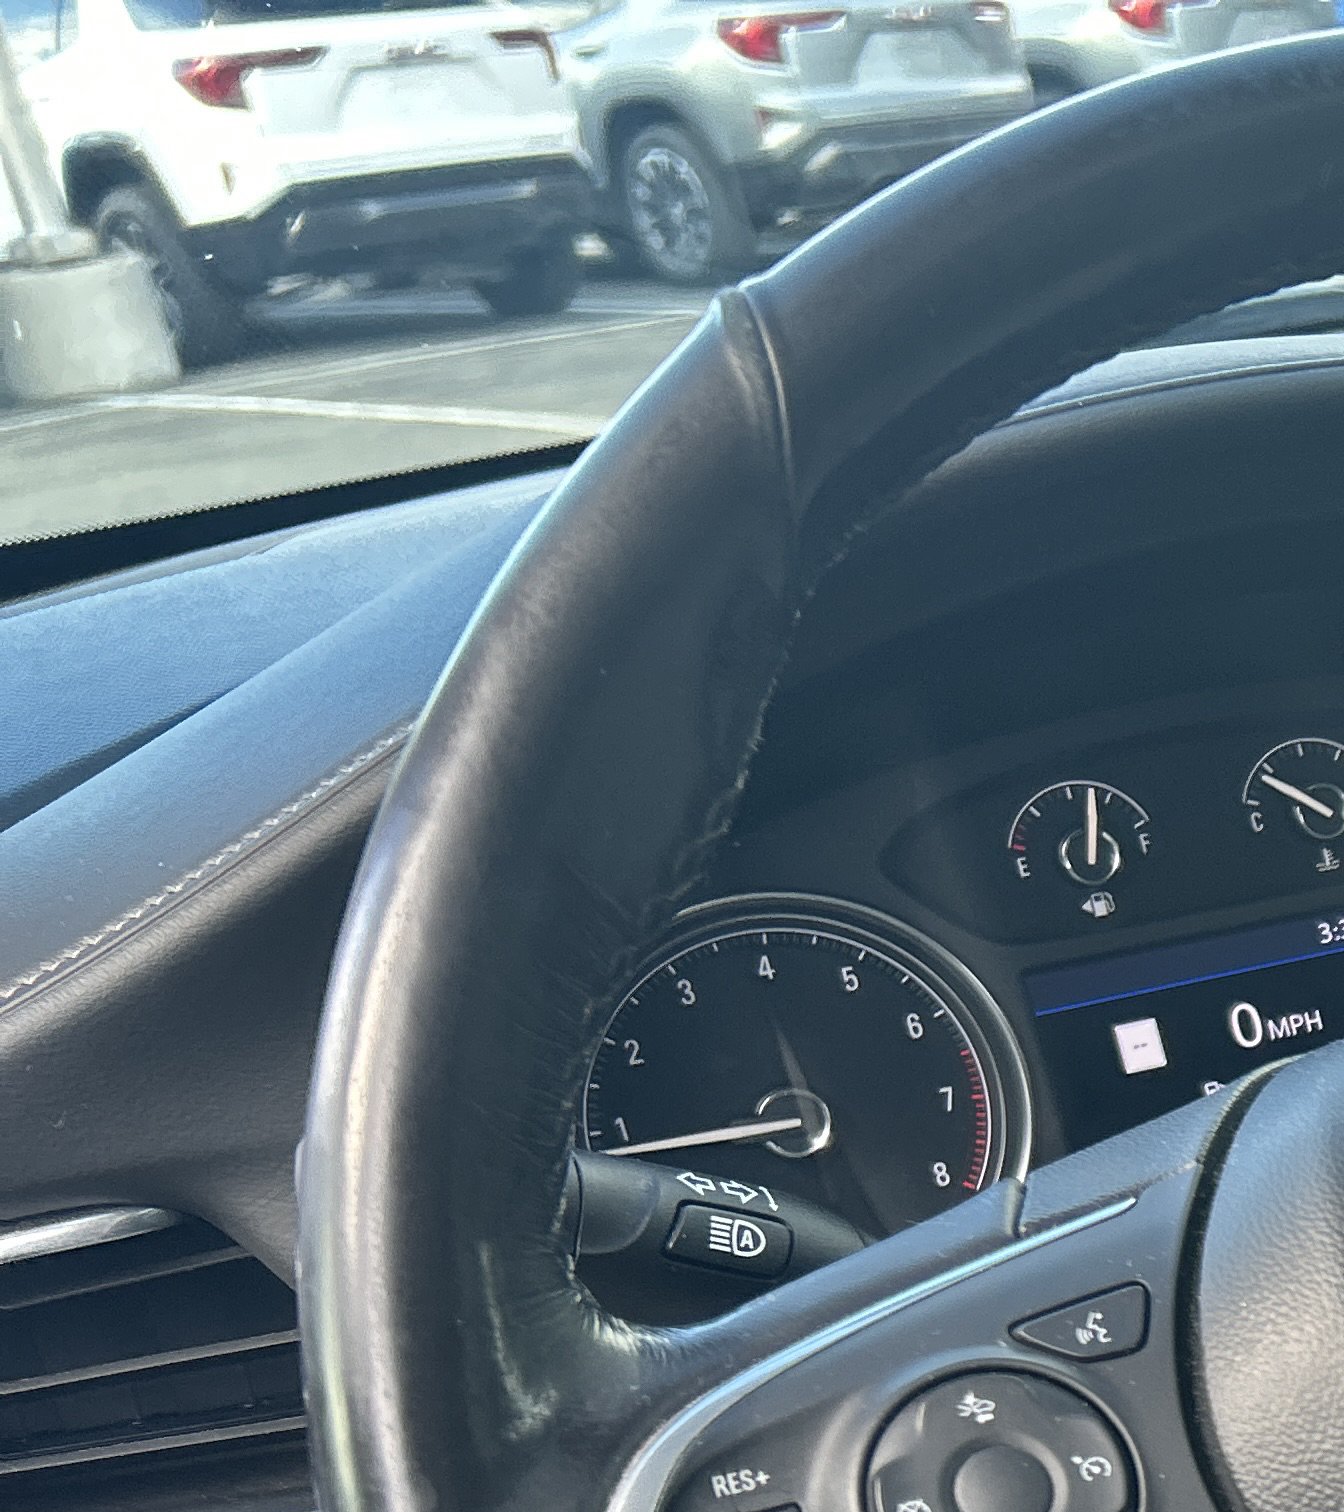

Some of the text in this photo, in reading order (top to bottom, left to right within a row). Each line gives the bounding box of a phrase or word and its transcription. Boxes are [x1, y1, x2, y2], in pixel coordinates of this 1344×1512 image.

[1250, 812, 1264, 833] C
[1140, 833, 1151, 855] F
[1017, 857, 1031, 878] E
[759, 955, 775, 981] 4
[841, 966, 860, 992] 5
[676, 978, 697, 1005] 3
[906, 1013, 924, 1040] 6
[1230, 1001, 1324, 1049] 0 MPH
[623, 1040, 645, 1067] 2
[939, 1087, 955, 1113] 7
[614, 1117, 628, 1143] 1
[932, 1162, 950, 1187] 8
[711, 1469, 771, 1497] RES+
